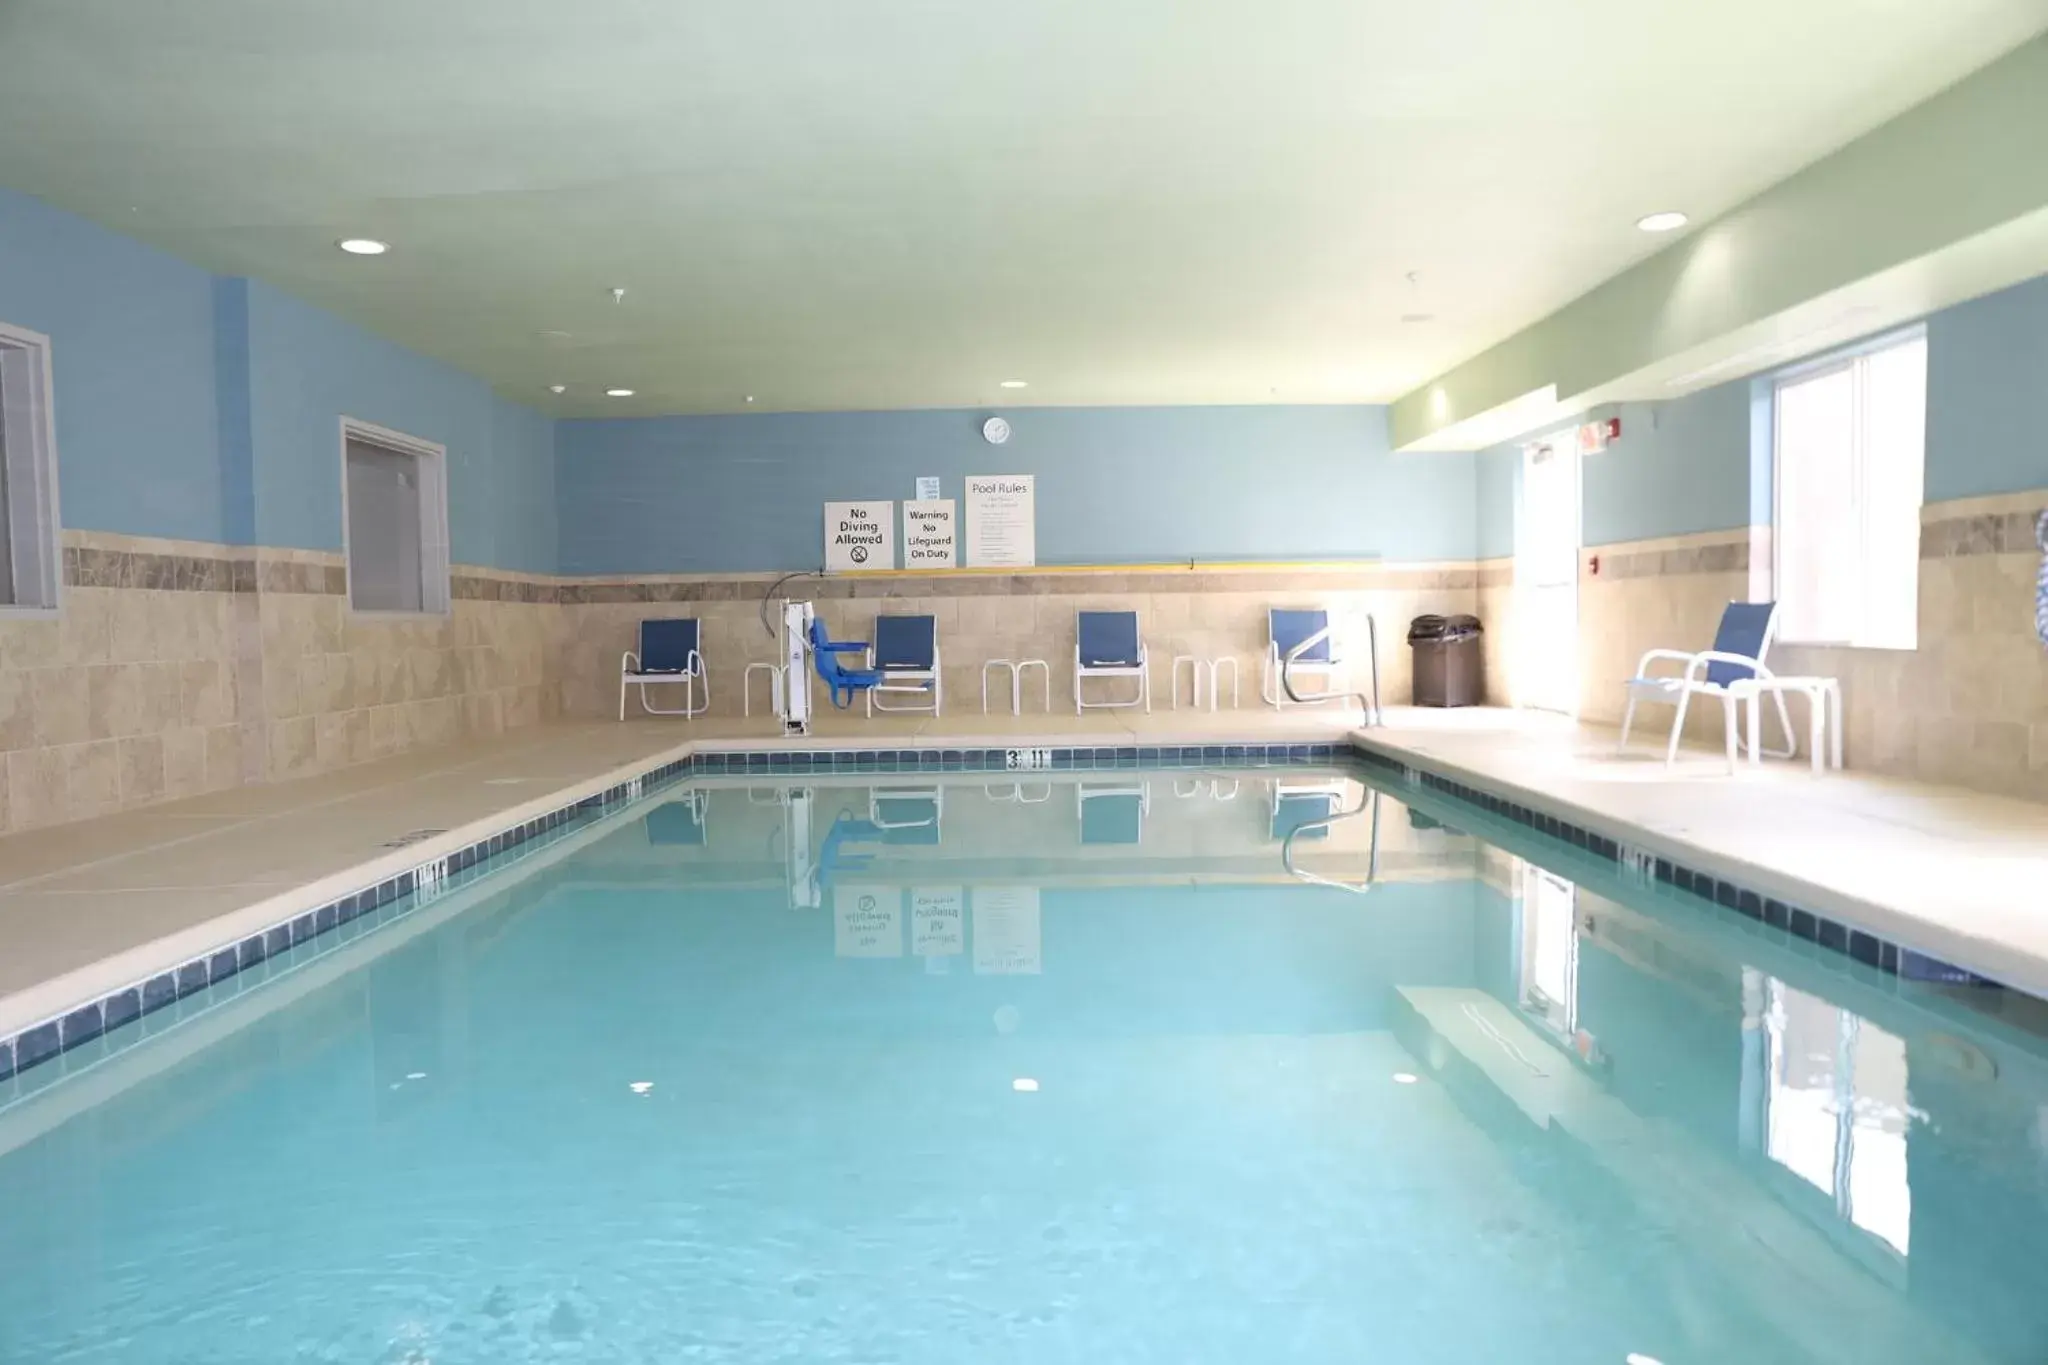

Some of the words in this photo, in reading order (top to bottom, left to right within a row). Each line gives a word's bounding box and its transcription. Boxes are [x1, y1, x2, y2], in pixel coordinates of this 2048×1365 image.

[972, 483, 996, 494] Pool
[999, 483, 1028, 494] Rules
[850, 508, 867, 519] No
[910, 510, 949, 521] Warning
[840, 521, 878, 533] Diving
[923, 524, 936, 532] No
[835, 534, 883, 545] Allowed
[908, 536, 951, 547] Lifeguard
[911, 550, 925, 559] On
[927, 550, 949, 560] Duty
